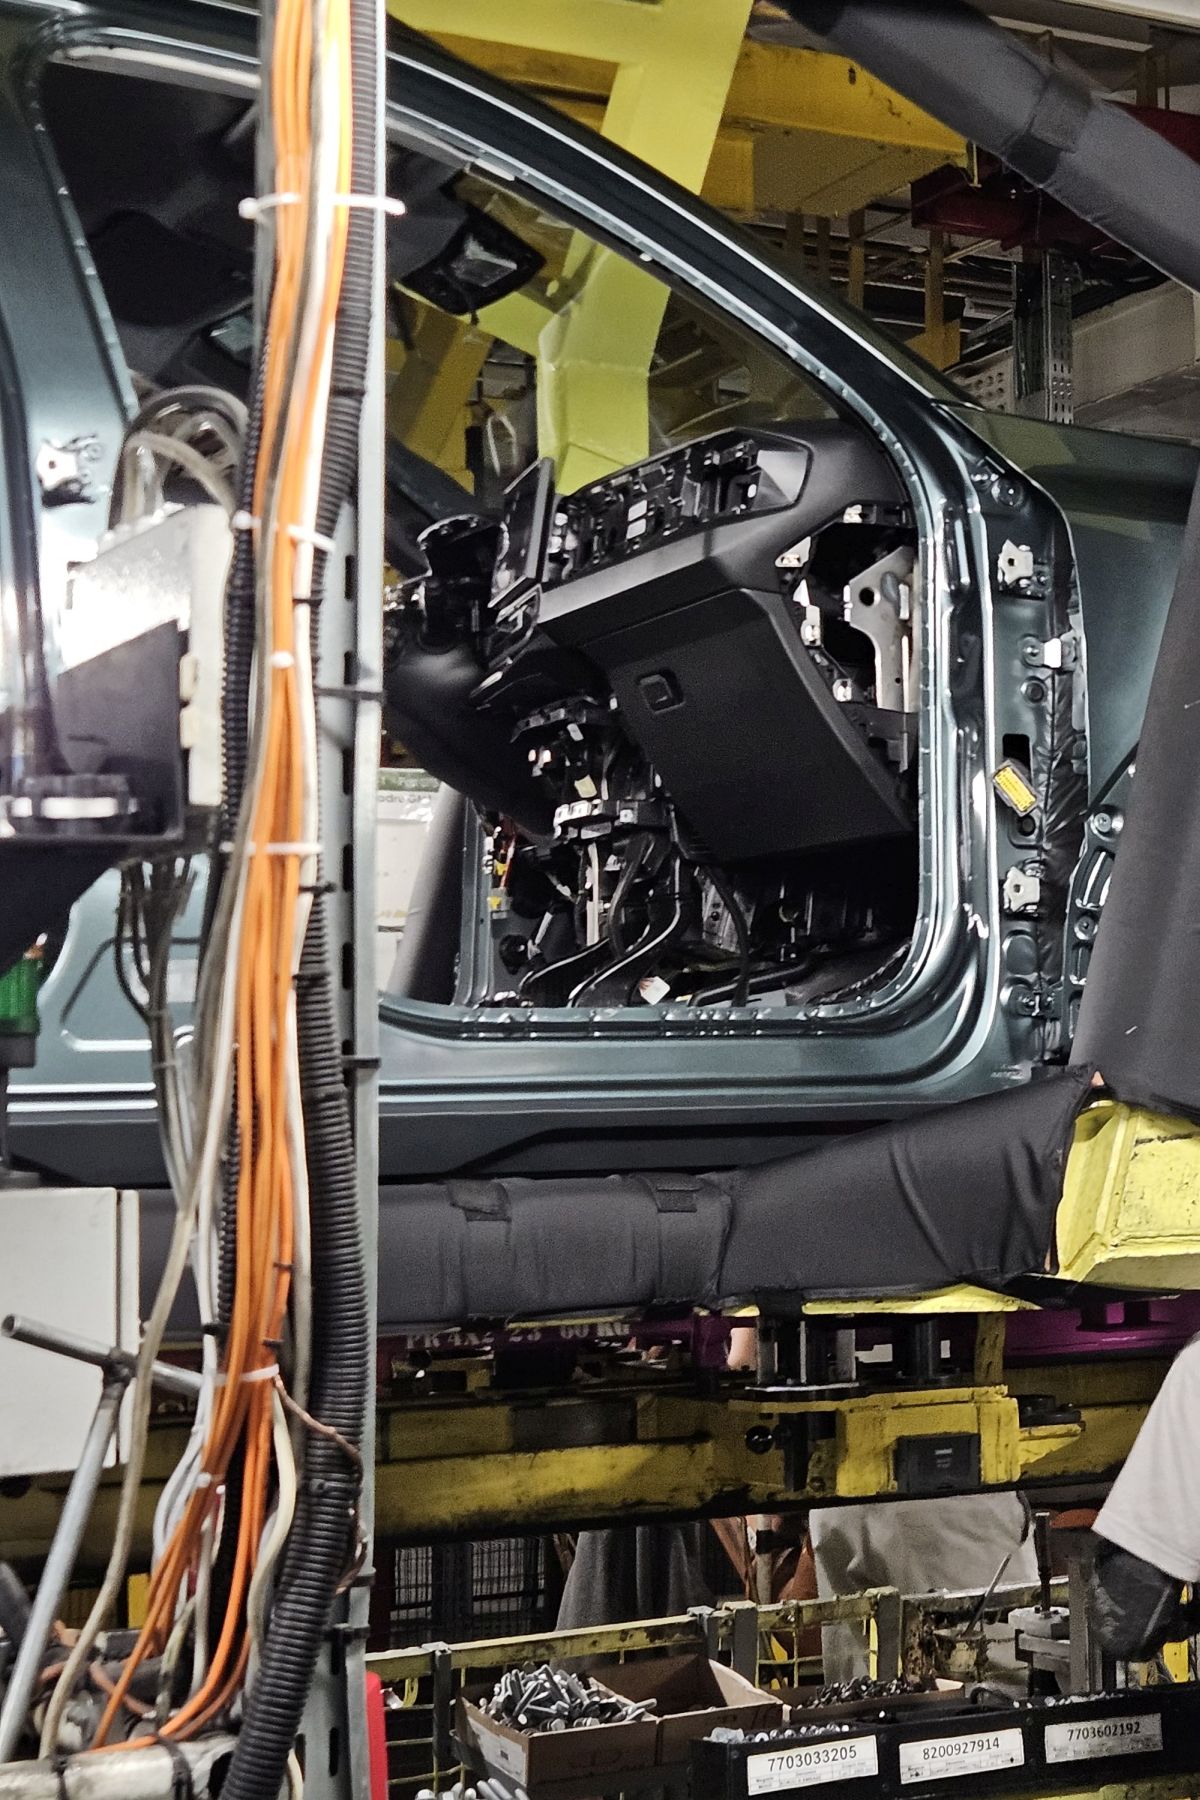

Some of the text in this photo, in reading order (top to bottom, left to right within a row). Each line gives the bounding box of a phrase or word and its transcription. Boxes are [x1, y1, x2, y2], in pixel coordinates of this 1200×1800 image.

[1067, 1721, 1141, 1741] 7703602192
[767, 1745, 857, 1772] 7703033205
[923, 1737, 1000, 1760] 8200927914
